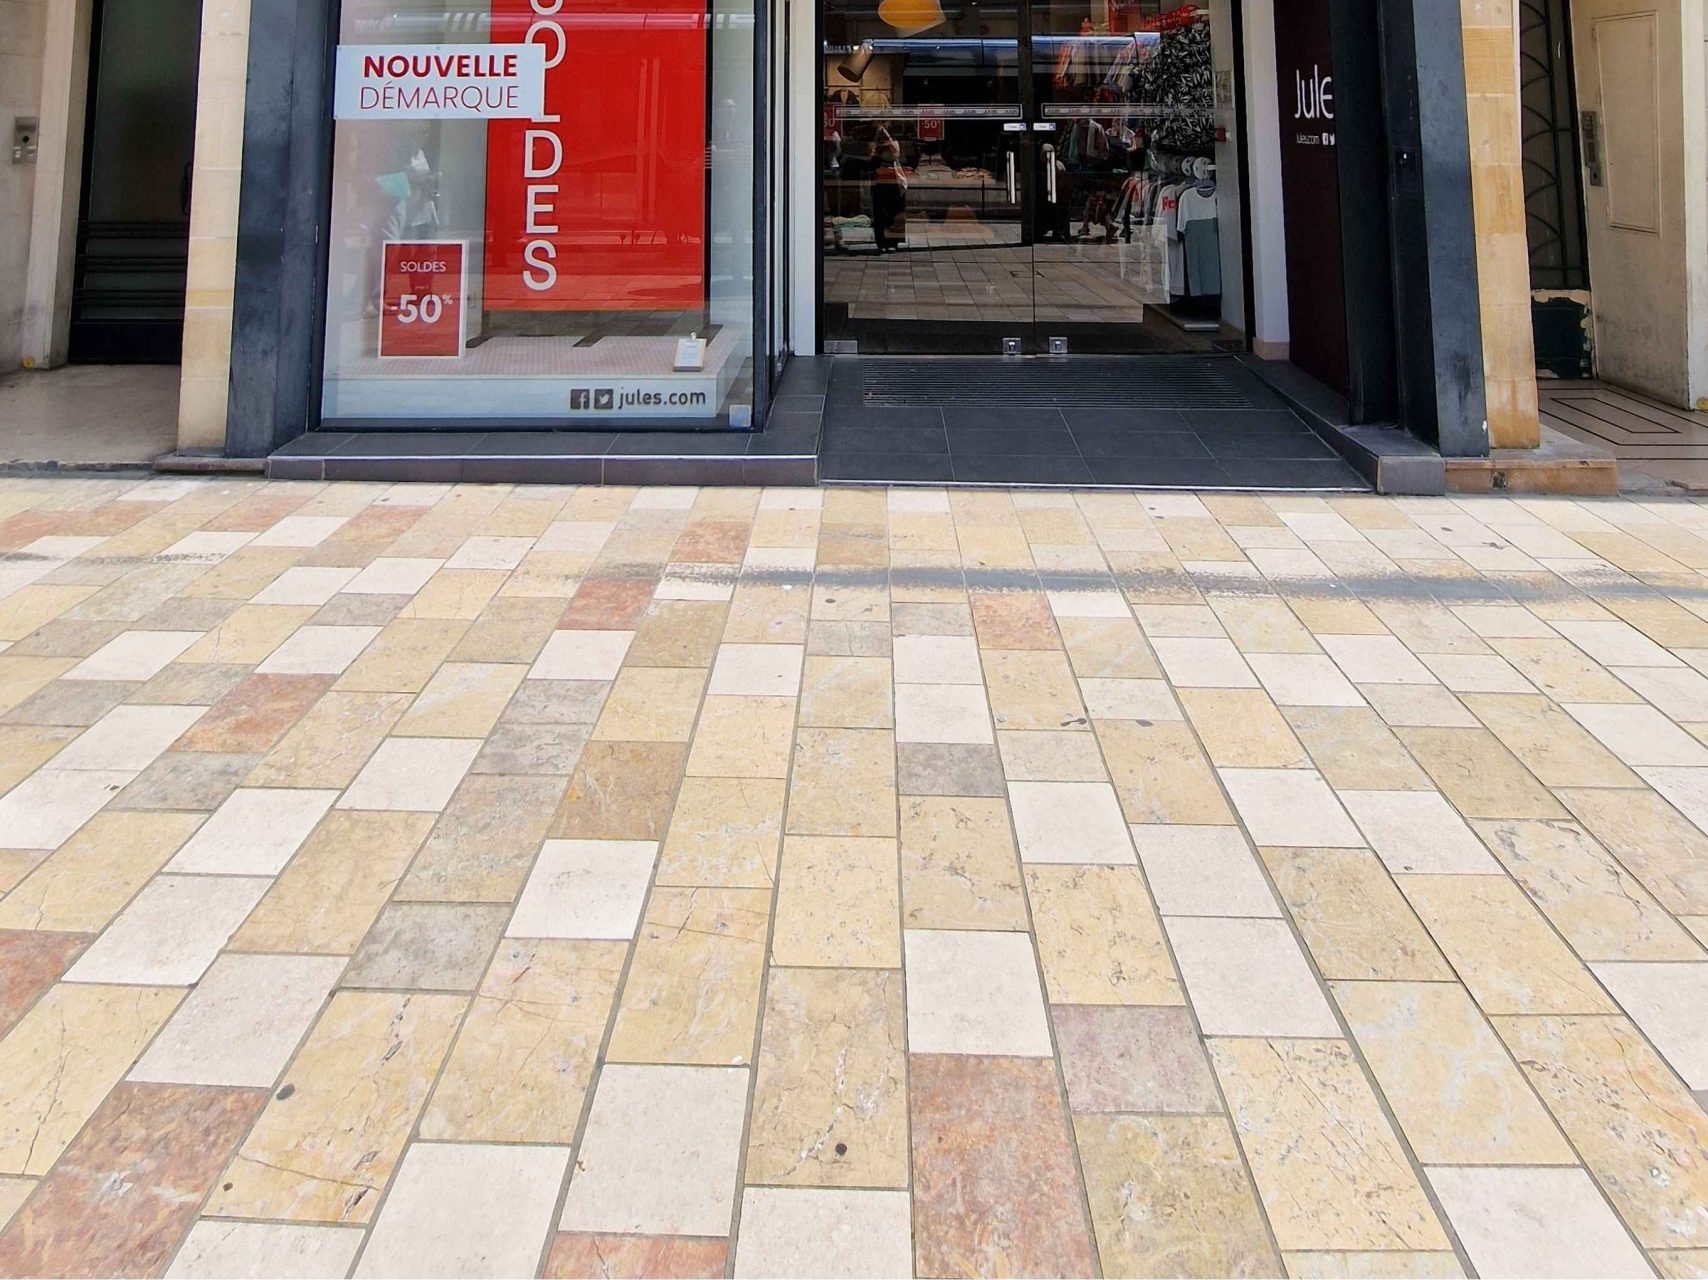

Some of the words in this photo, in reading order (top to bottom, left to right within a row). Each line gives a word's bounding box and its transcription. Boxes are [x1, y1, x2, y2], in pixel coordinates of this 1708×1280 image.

[363, 54, 518, 78] NOUVELLE
[360, 80, 519, 112] DÉMARQUE
[1294, 64, 1334, 119] Jule
[400, 261, 447, 272] SOLDES
[618, 387, 706, 409] jules.com
